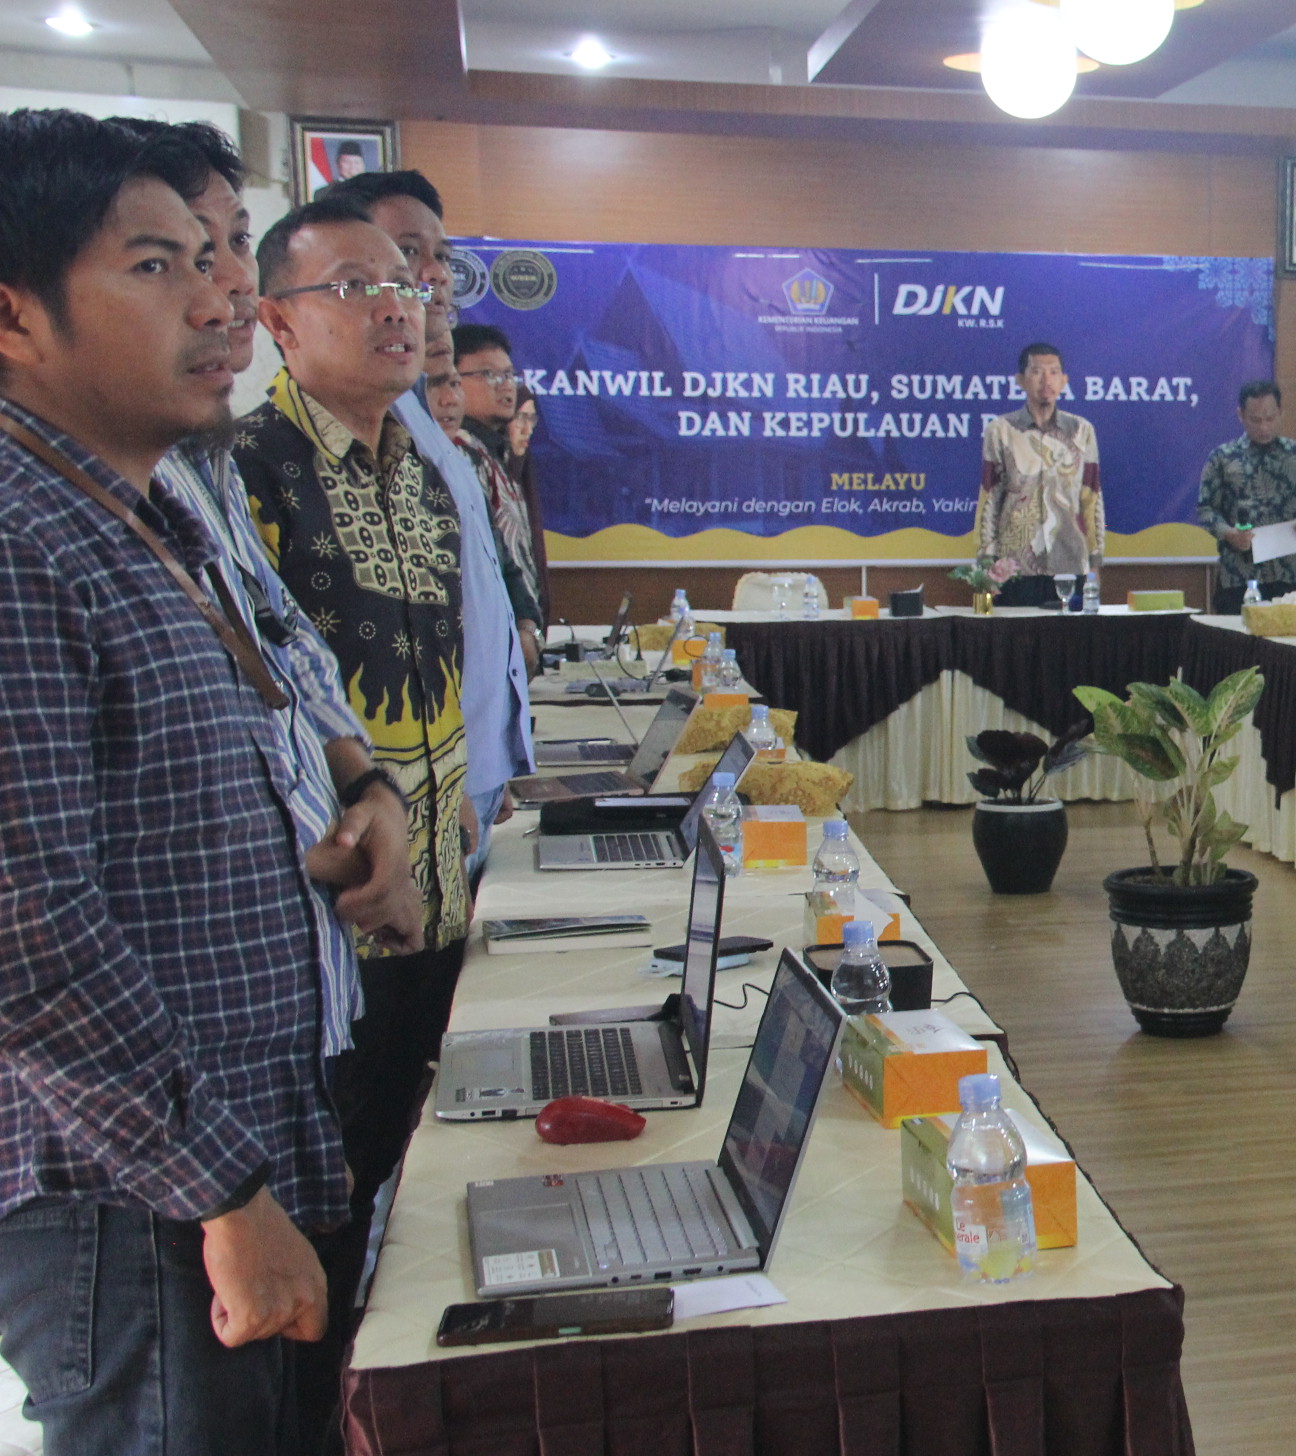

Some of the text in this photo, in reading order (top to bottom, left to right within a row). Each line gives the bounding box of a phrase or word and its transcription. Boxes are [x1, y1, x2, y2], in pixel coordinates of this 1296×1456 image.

[892, 284, 1004, 316] DJKN
[523, 369, 1199, 407] KANWIL DJKN RIAU, SUMATEA BARAT,
[678, 411, 751, 437] DAN
[762, 412, 969, 438] KEPULAUAN
[831, 473, 926, 491] MELAYU
[741, 497, 816, 517] dengan
[821, 497, 863, 515] Elok,
[867, 497, 926, 515] Akrab,
